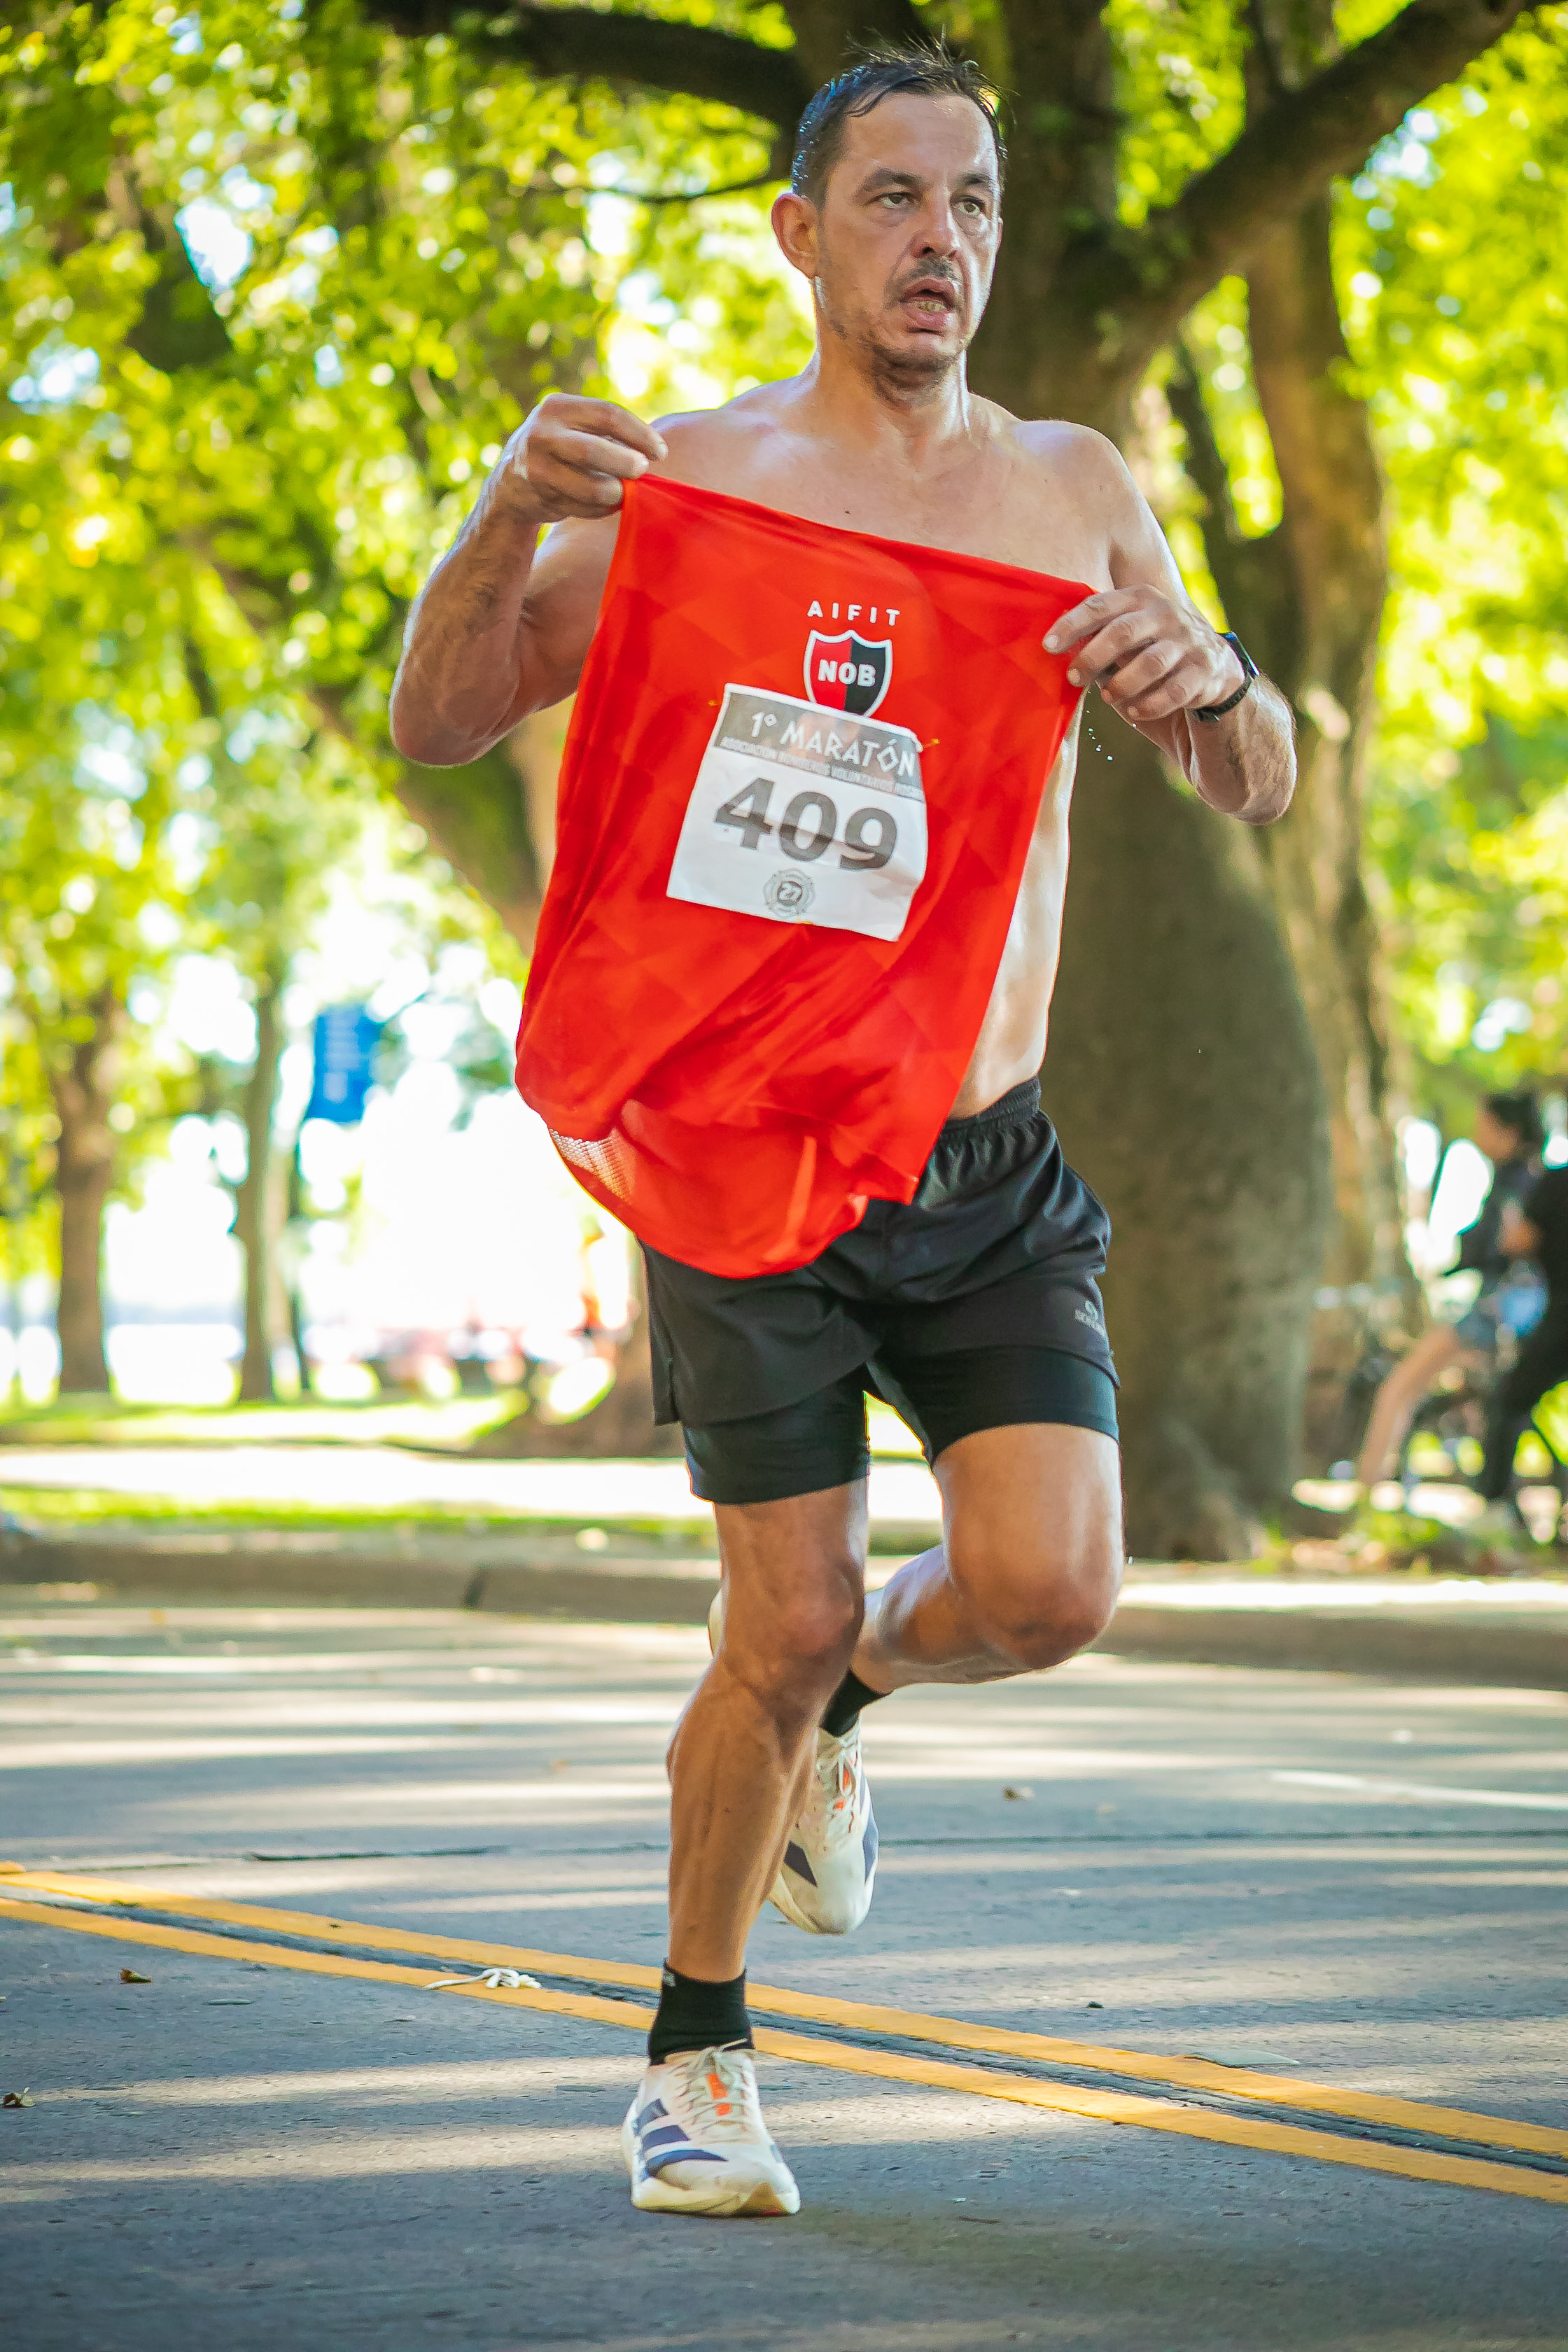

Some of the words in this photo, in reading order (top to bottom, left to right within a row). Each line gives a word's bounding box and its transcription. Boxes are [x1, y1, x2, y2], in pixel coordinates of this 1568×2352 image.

[807, 600, 900, 626] AIFIT
[818, 659, 876, 687] NOB
[779, 720, 916, 778] MARATÓN
[715, 777, 898, 871] 409
